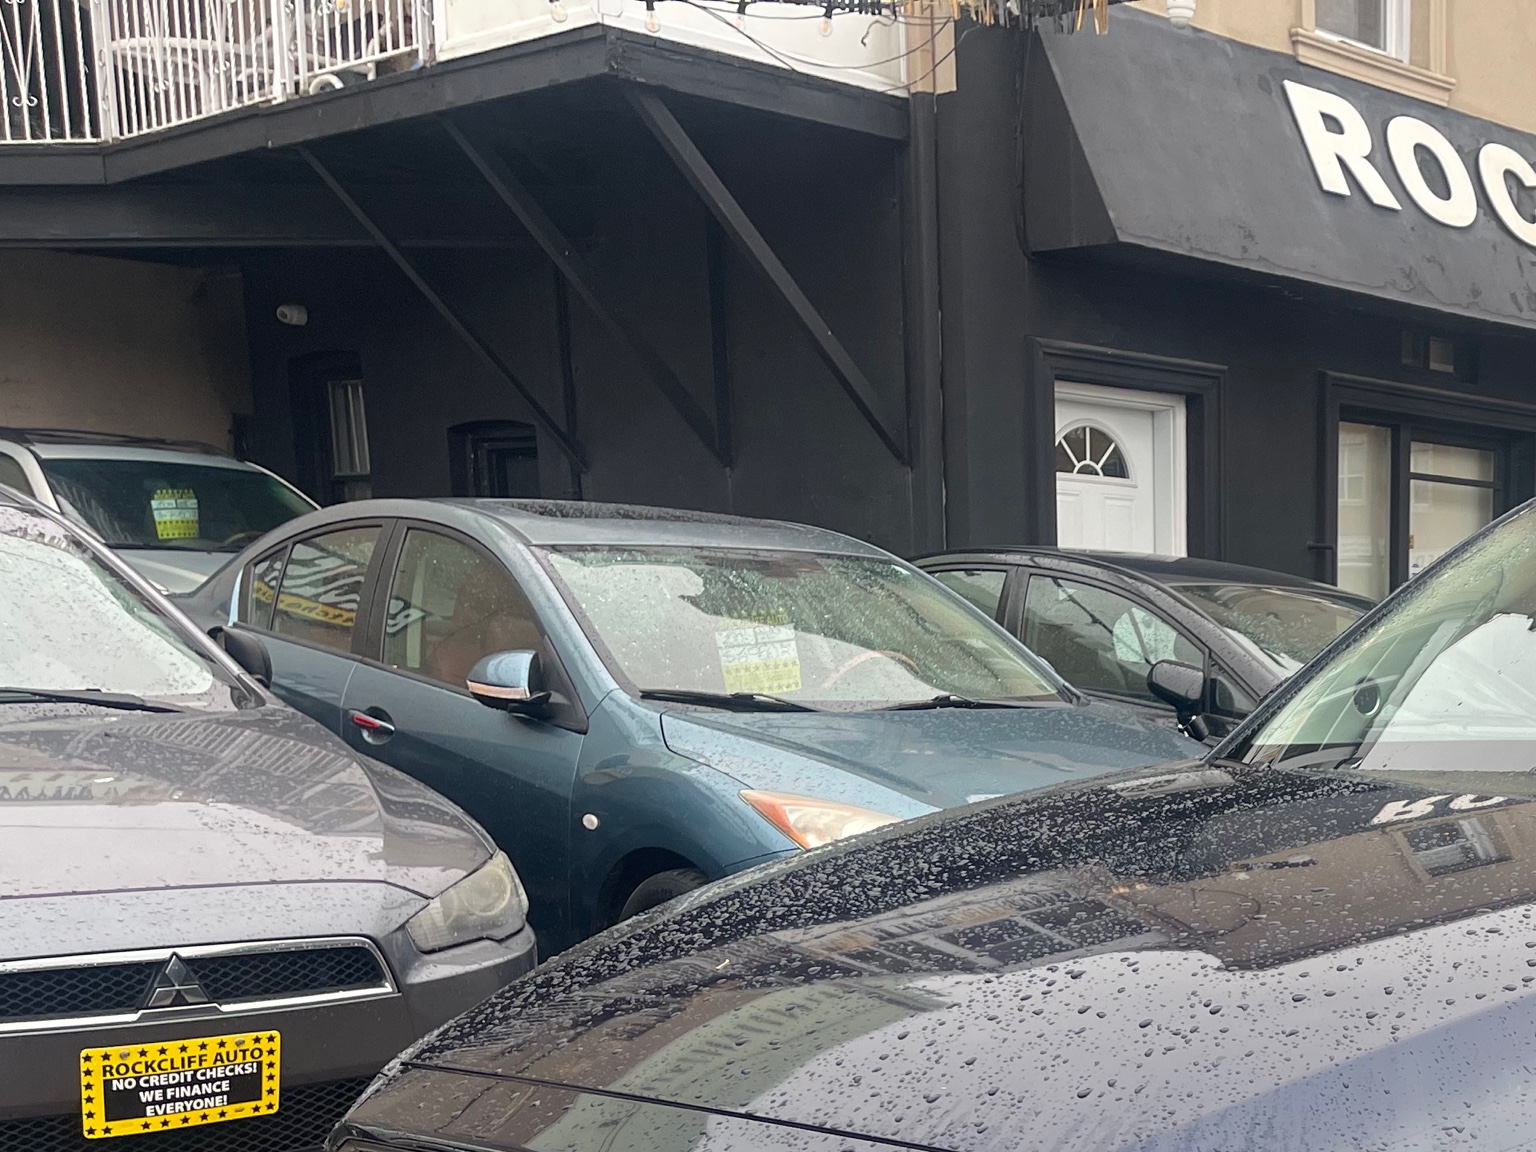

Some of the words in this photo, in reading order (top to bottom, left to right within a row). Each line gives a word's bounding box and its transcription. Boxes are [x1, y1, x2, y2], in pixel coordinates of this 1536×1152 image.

[102, 1054, 208, 1078] ROCKCLIFF
[213, 1047, 264, 1065] AUTO
[112, 1077, 136, 1091] NO
[139, 1071, 194, 1088] CREDIT
[196, 1062, 258, 1079] CHECKS!
[139, 1089, 163, 1103] WE
[166, 1080, 230, 1101] FINANCE
[146, 1095, 228, 1117] EVERYONE!
